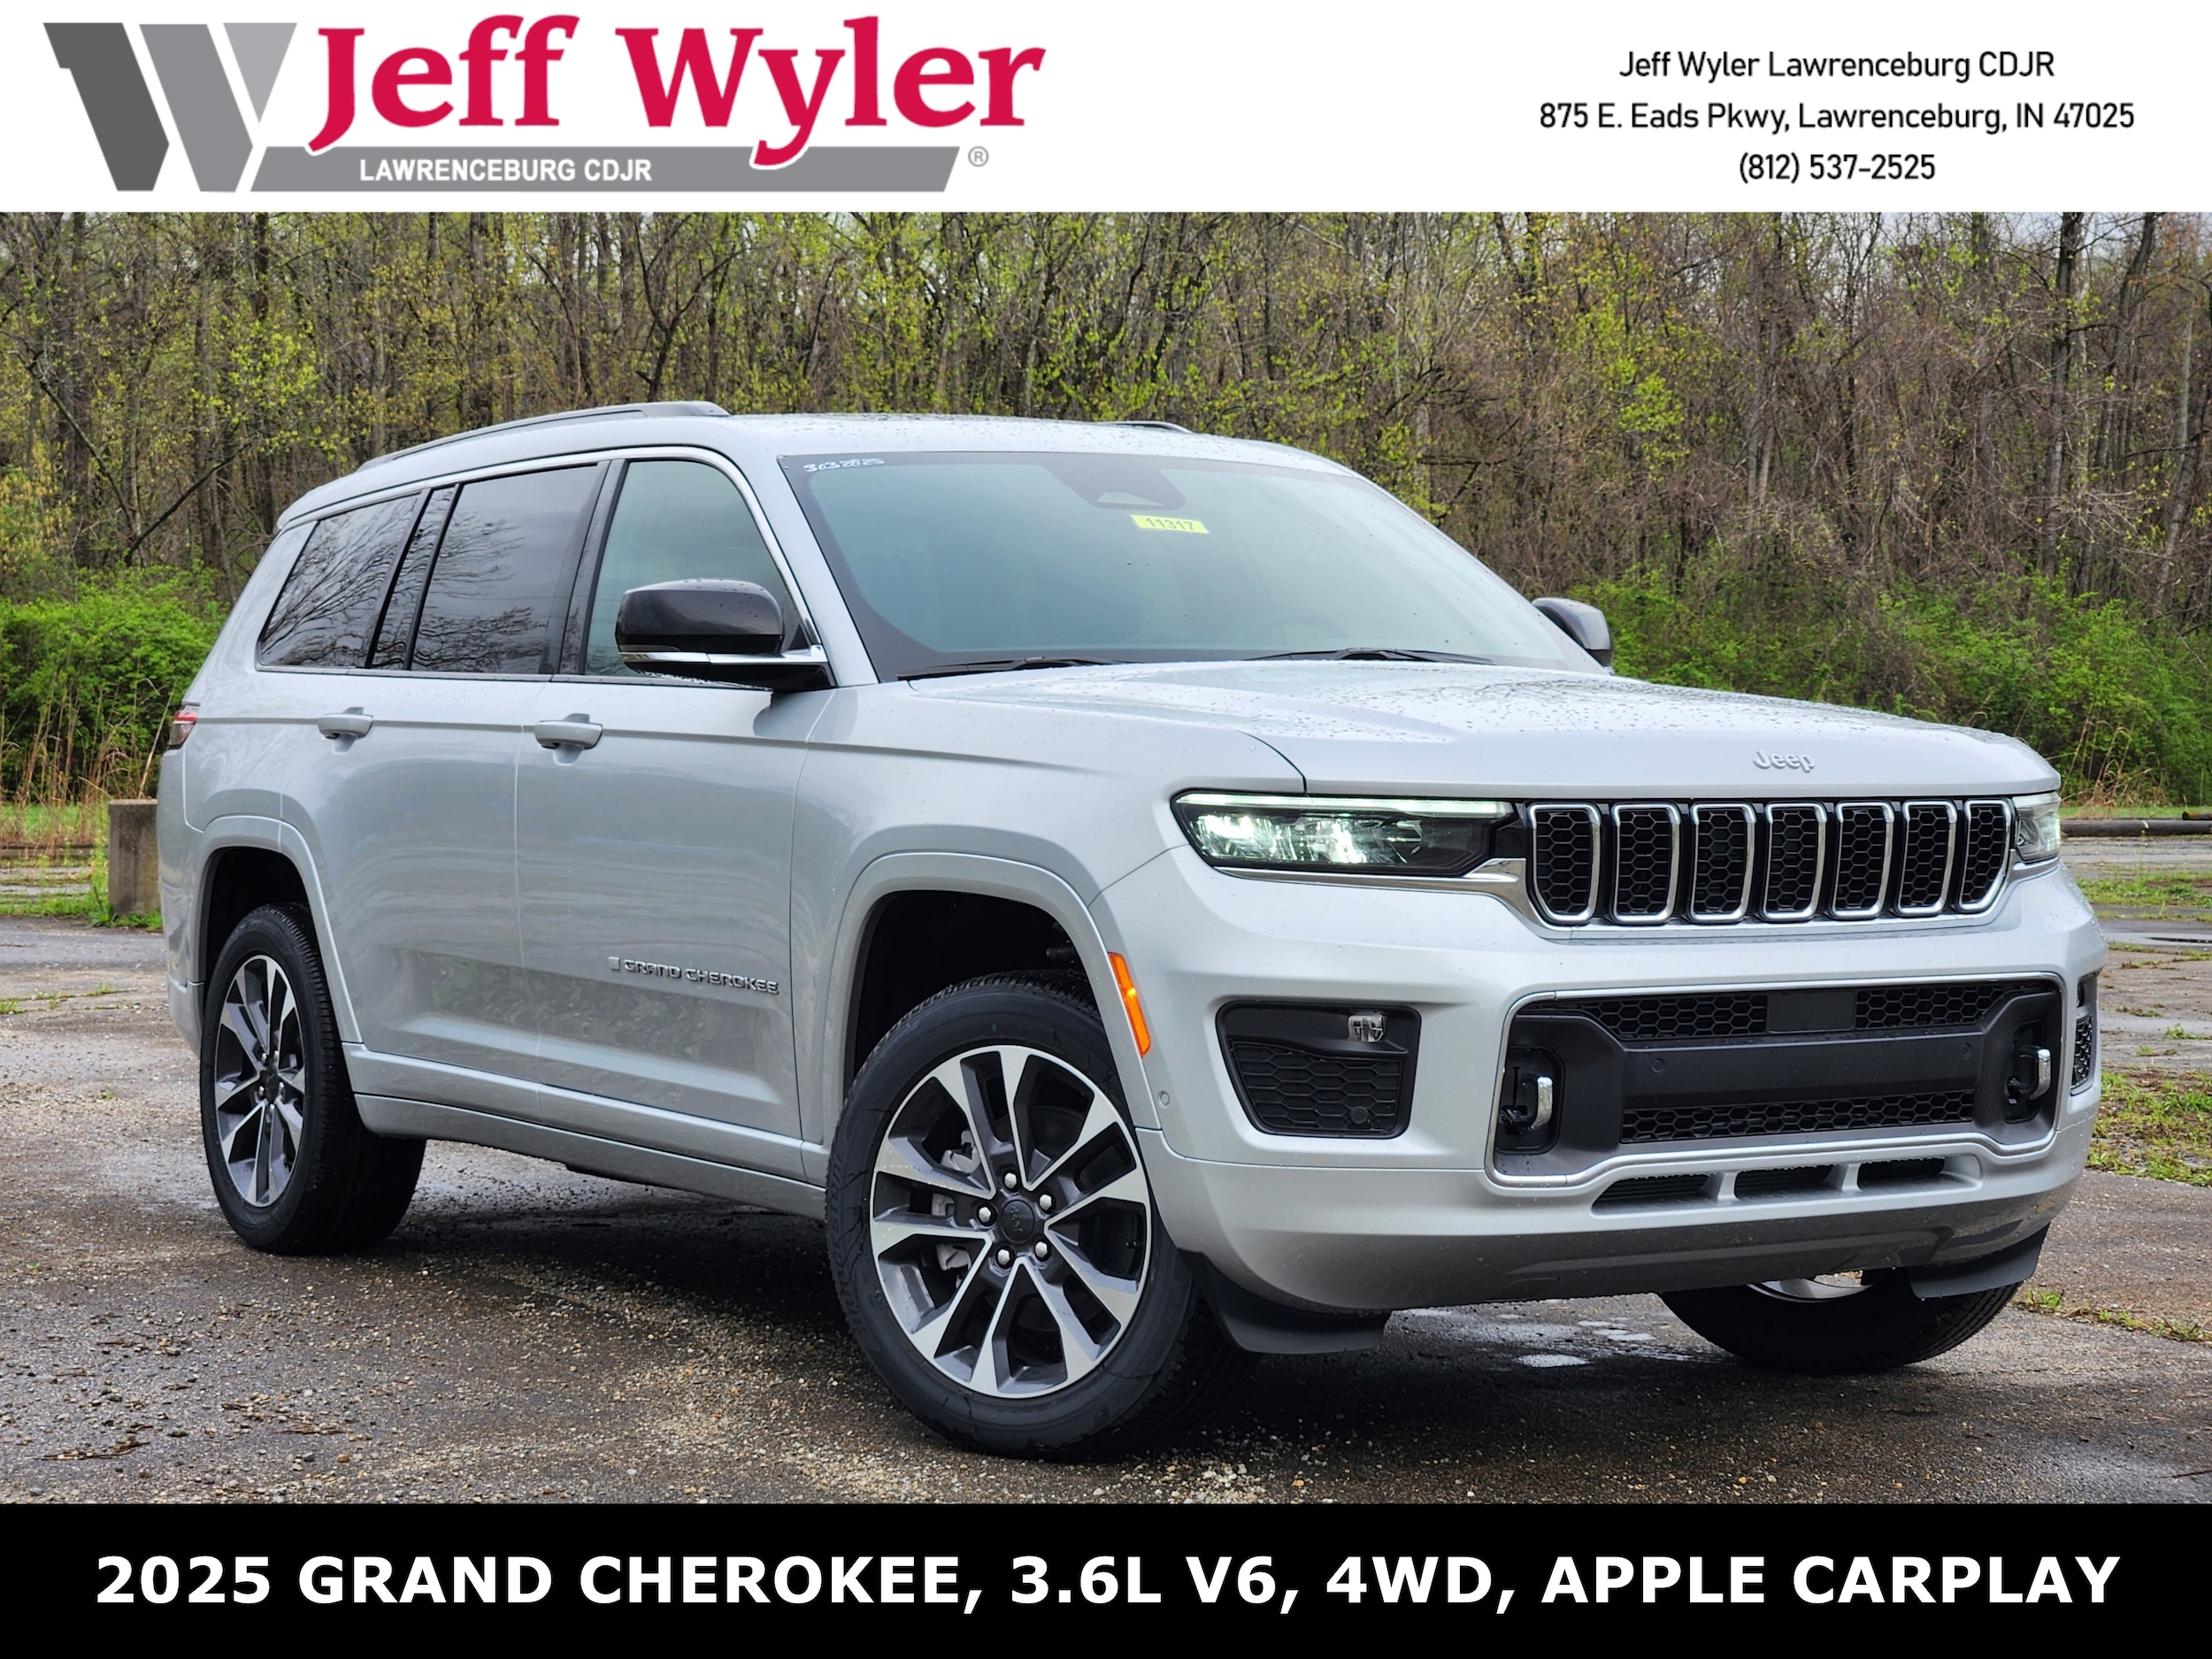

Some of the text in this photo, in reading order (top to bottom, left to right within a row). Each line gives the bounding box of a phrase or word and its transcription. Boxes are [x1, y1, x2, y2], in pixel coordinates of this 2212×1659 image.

[1146, 518, 1194, 531] 11317
[1752, 749, 1815, 773] Jeep
[623, 959, 779, 995] GRAND CHEROKEE
